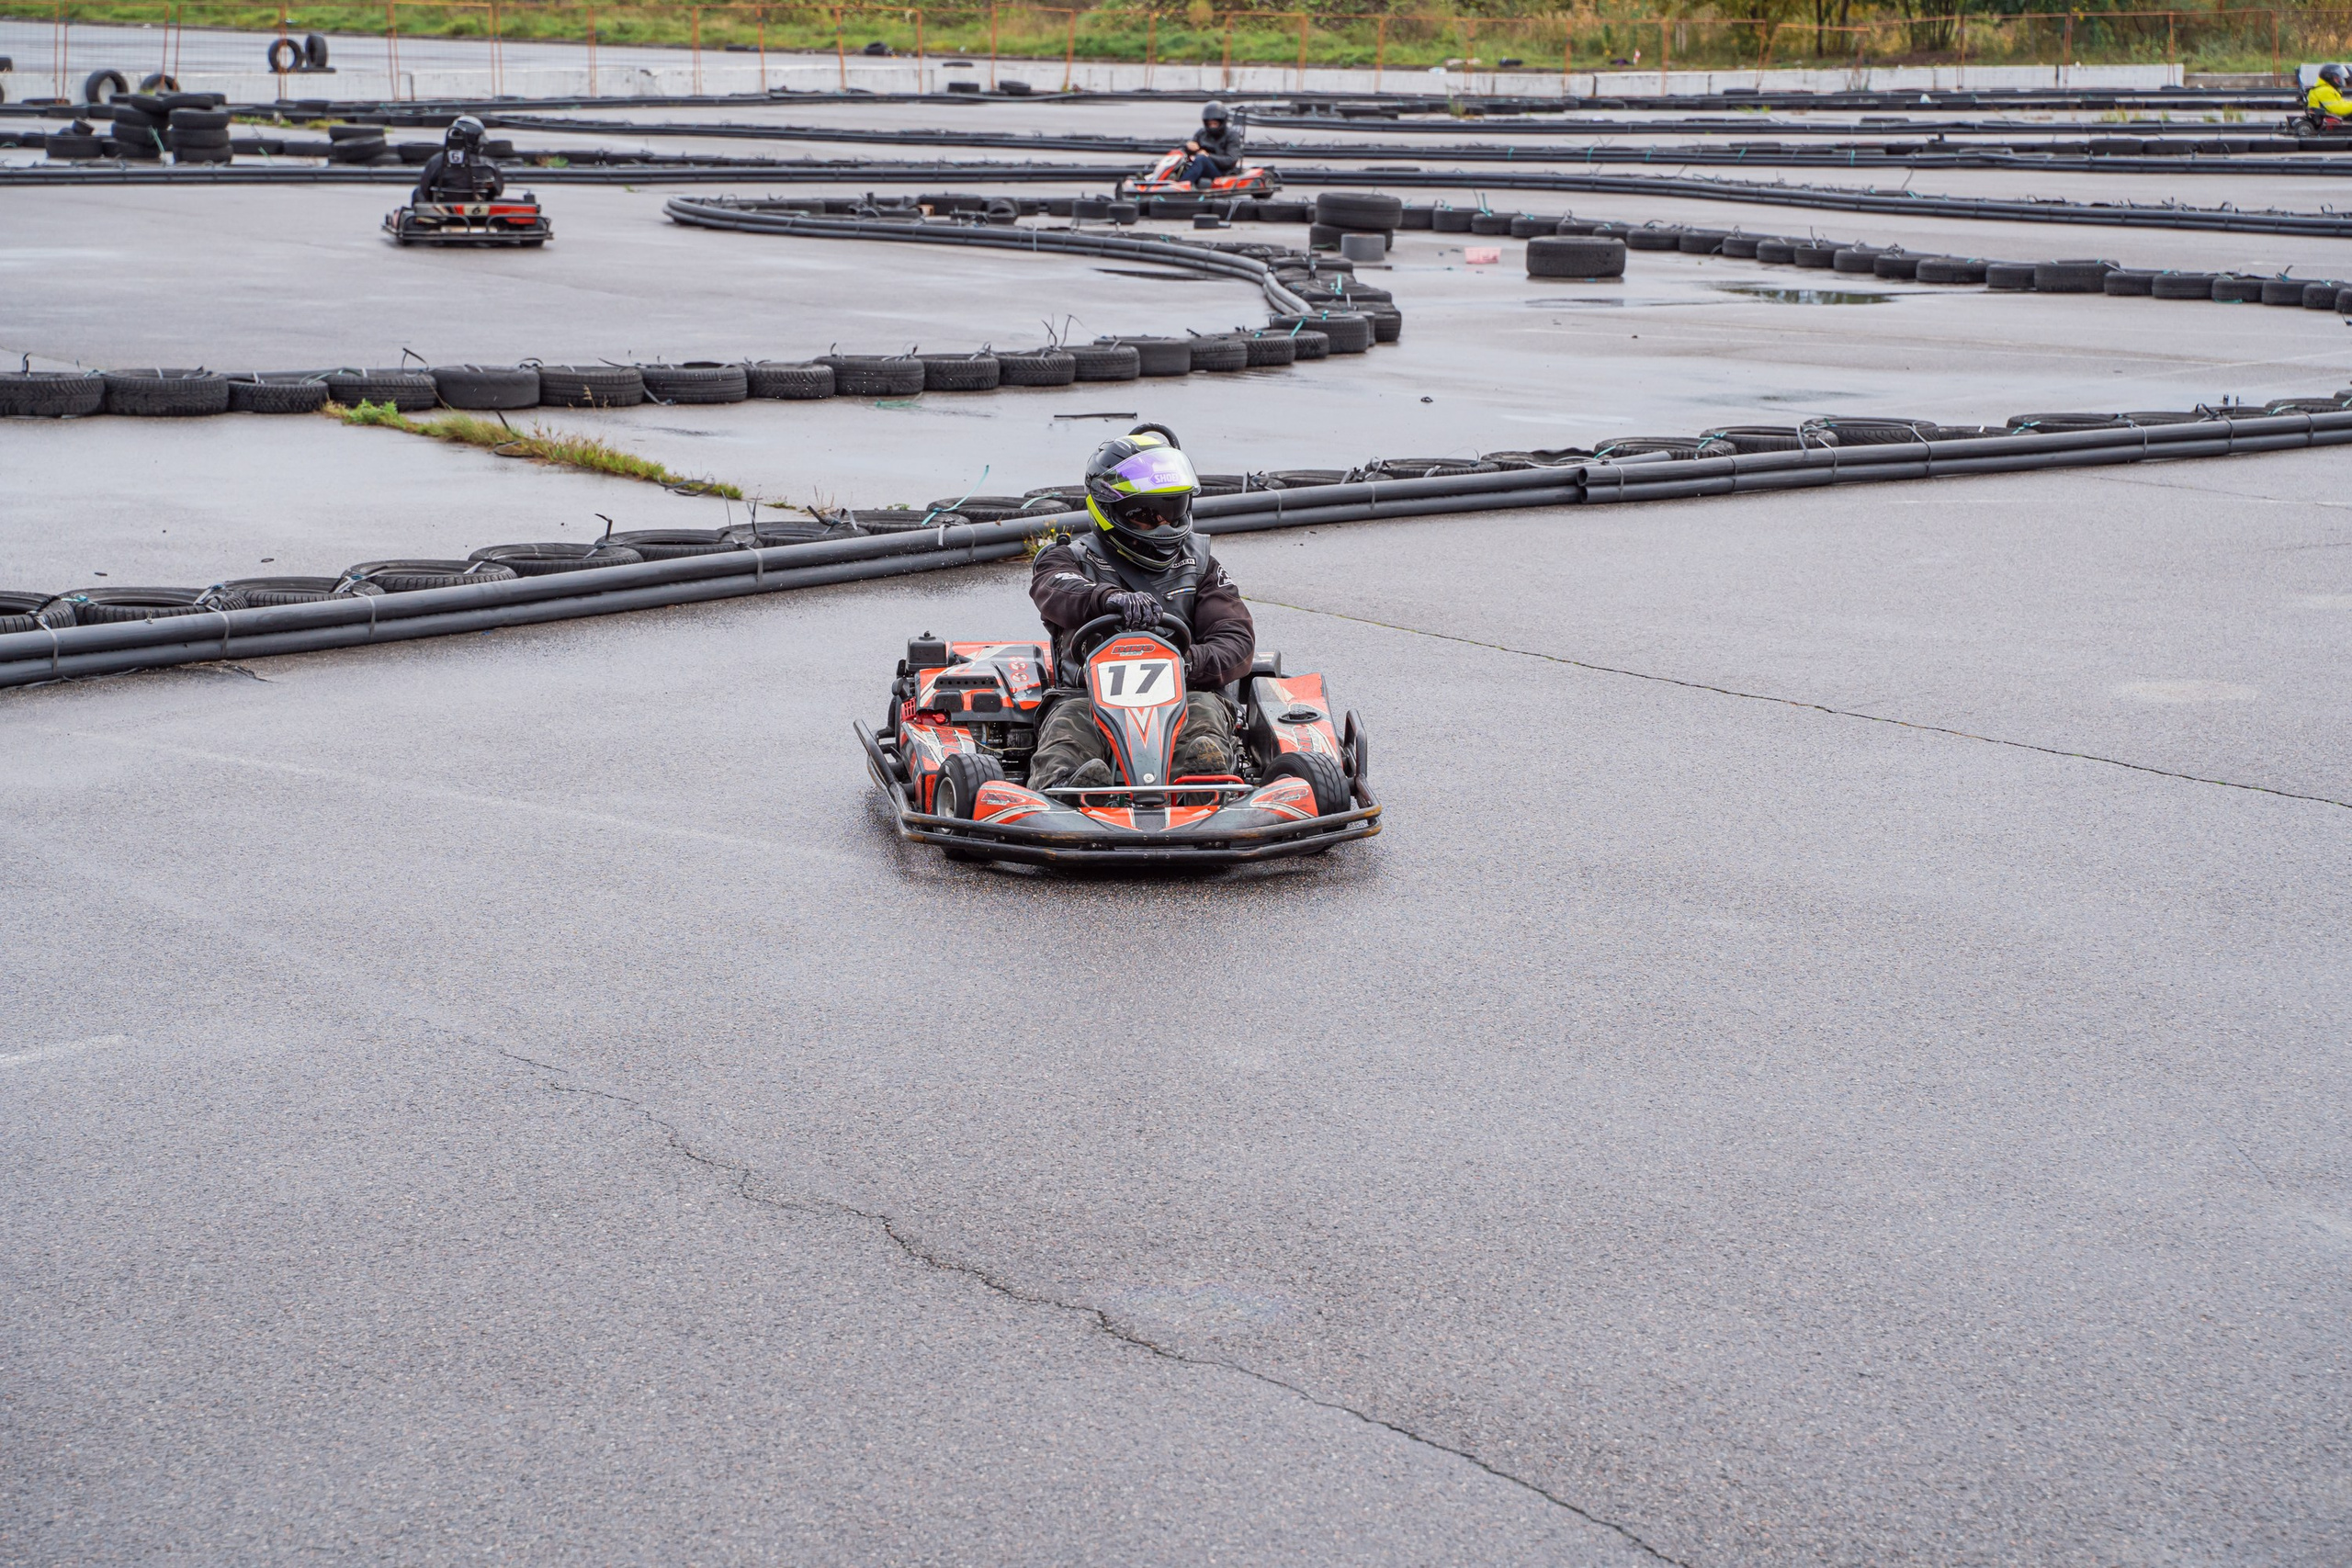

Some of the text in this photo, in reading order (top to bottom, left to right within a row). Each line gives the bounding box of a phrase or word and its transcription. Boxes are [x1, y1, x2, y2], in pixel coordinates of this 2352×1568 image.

[452, 152, 459, 163] 6
[1112, 645, 1155, 653] DINO
[1108, 663, 1169, 696] 17
